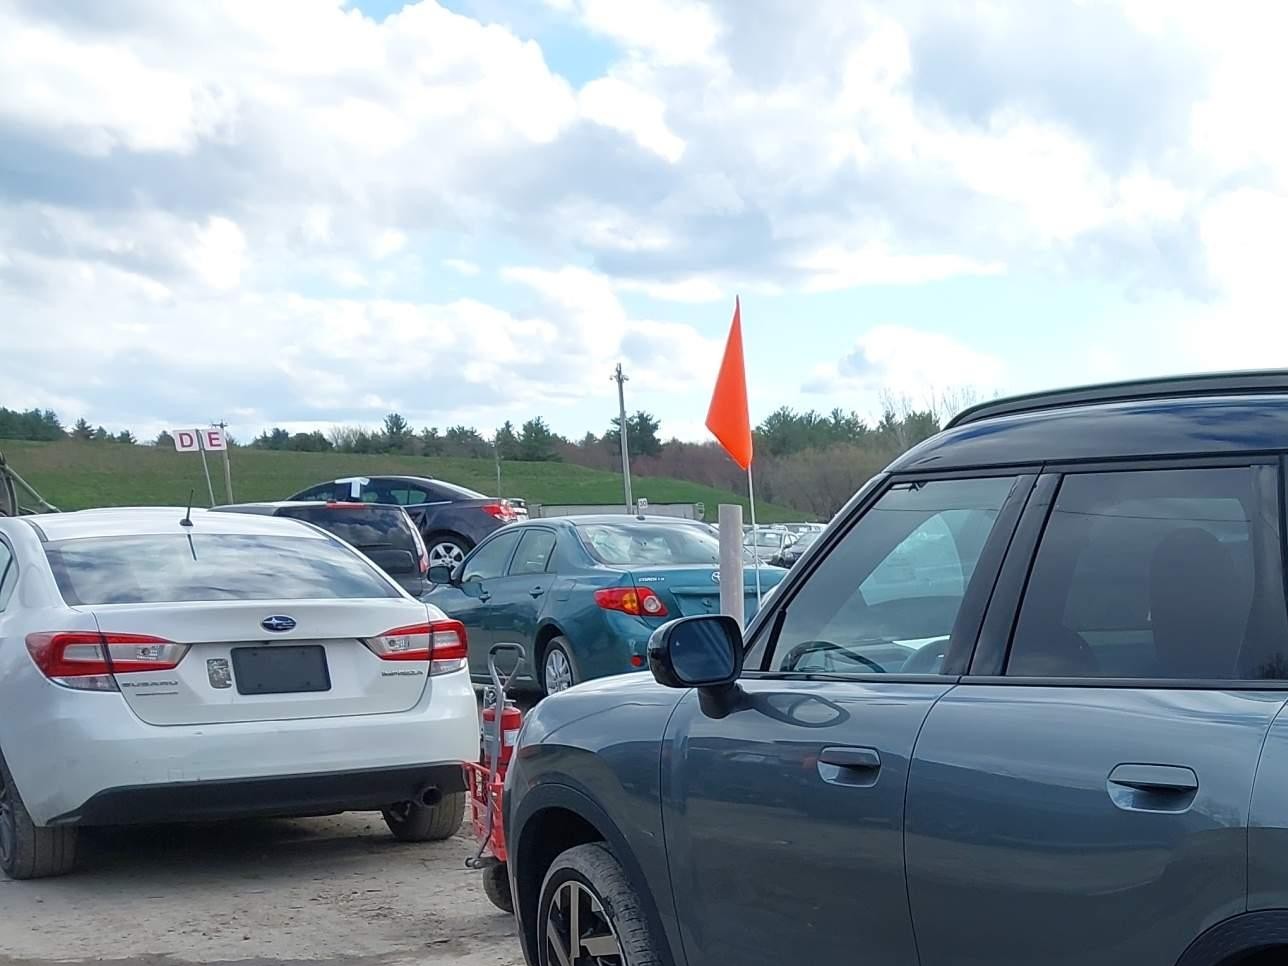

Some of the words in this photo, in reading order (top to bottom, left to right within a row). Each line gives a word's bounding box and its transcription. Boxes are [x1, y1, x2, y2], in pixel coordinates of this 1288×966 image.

[178, 432, 194, 448] D
[207, 431, 222, 447] E
[121, 680, 179, 688] SUBARU
